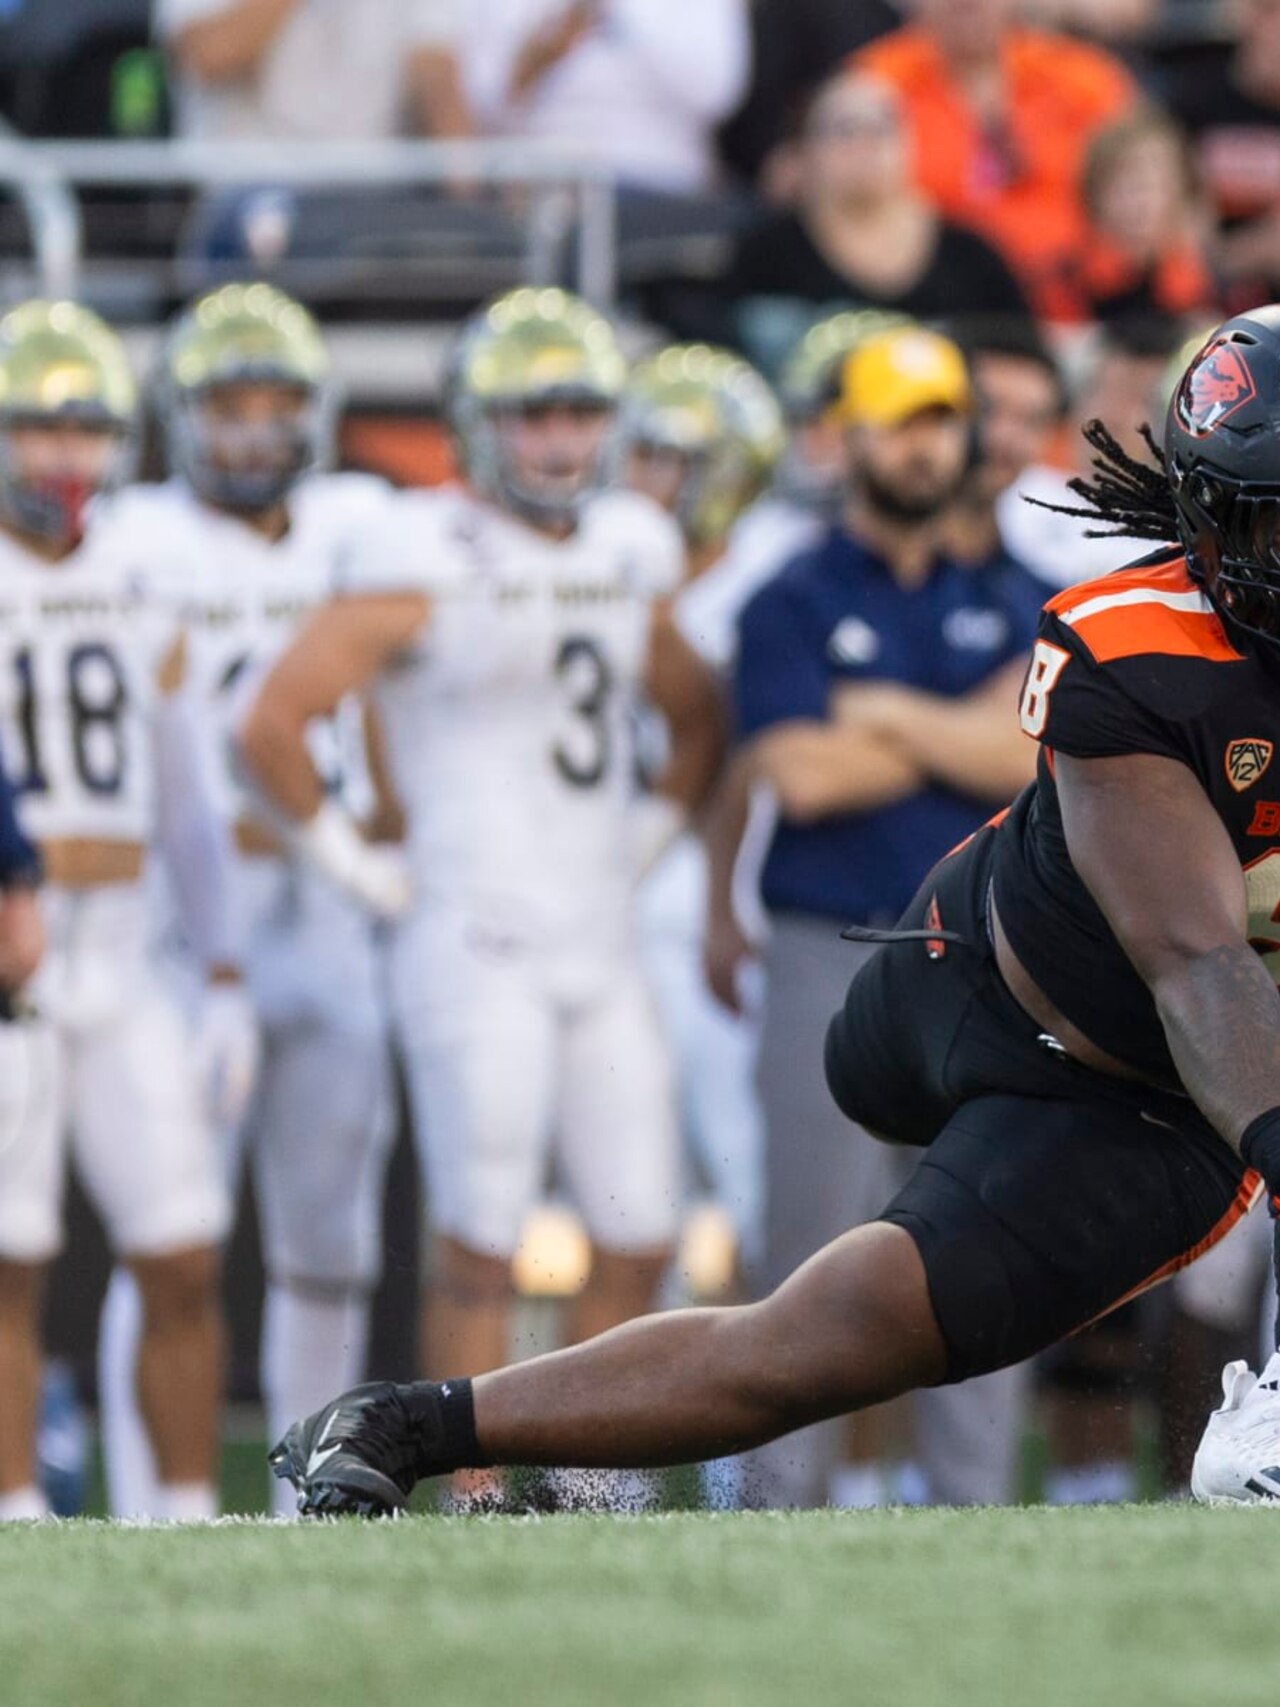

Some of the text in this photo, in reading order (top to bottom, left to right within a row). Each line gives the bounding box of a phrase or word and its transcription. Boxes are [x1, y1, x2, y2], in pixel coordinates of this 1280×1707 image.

[13, 643, 128, 794] 18
[552, 634, 611, 792] 3
[1018, 638, 1072, 741] 8
[1232, 762, 1256, 781] 12
